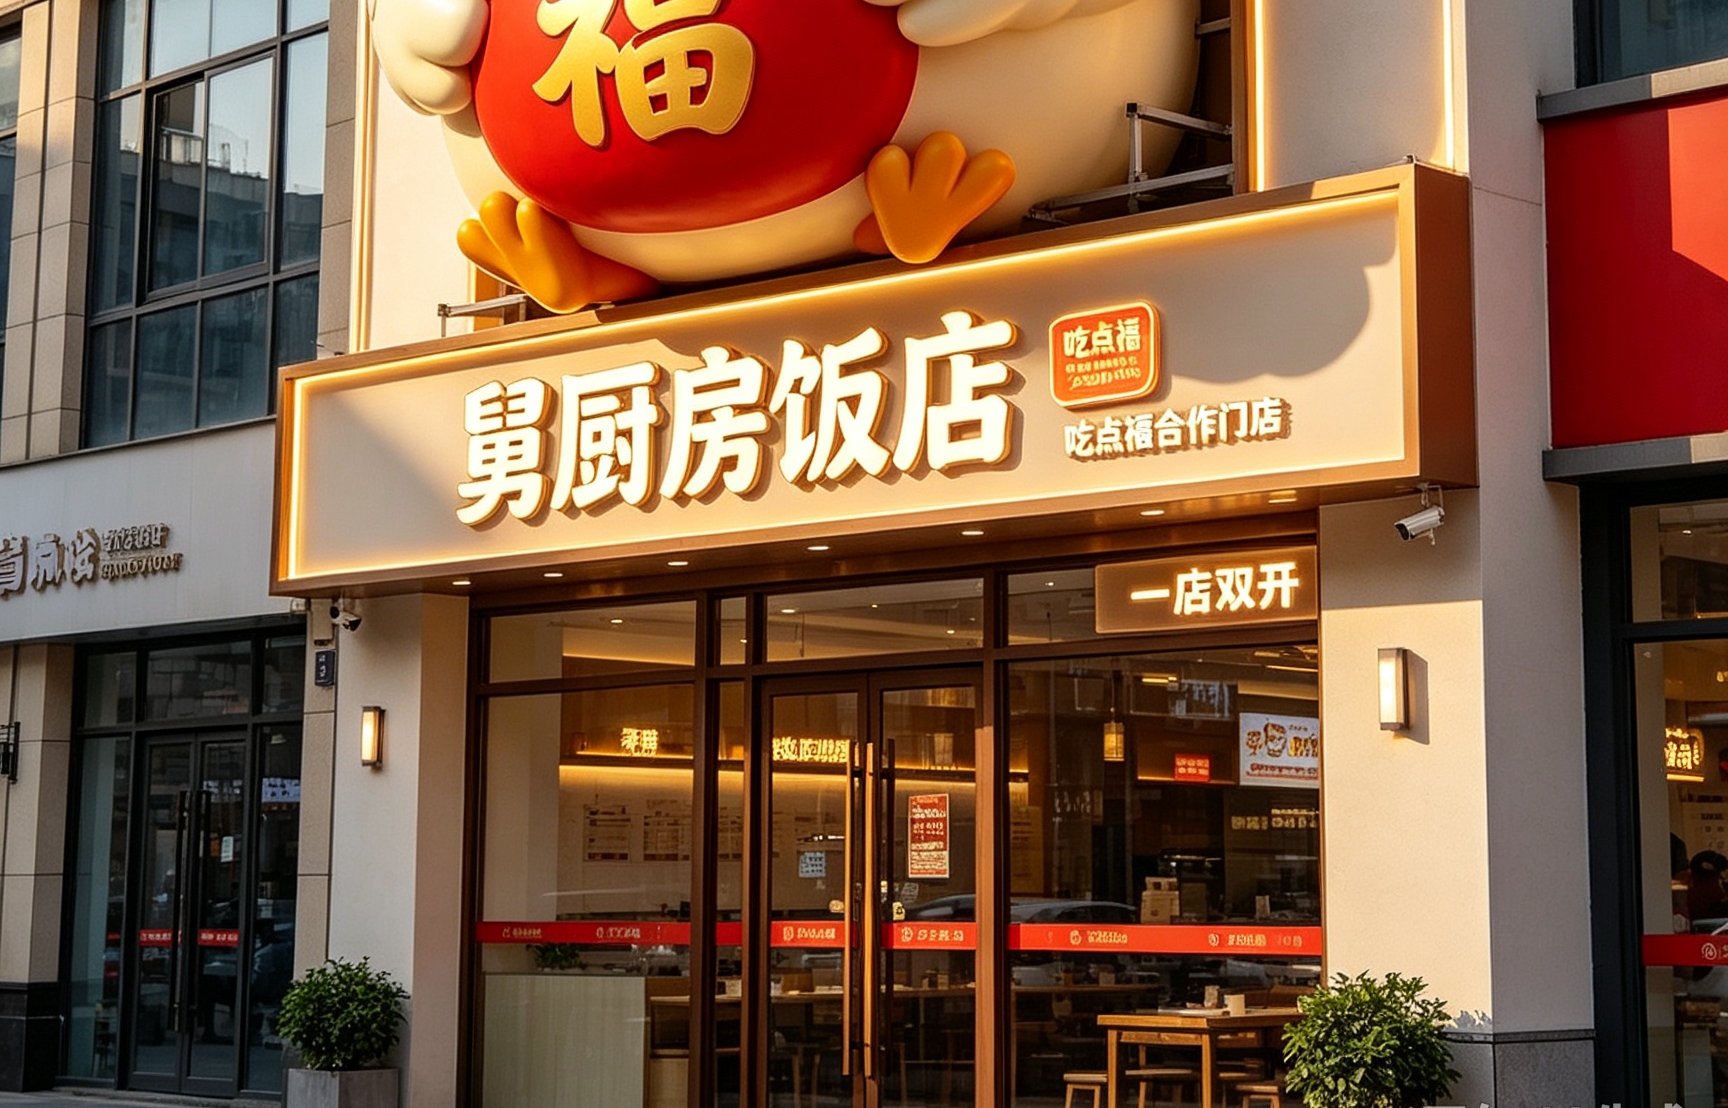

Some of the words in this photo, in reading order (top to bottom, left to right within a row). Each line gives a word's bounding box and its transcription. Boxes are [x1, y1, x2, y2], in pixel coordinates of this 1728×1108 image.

[1063, 316, 1141, 359] 吃点福
[456, 310, 1014, 525] 舅厨房饭店
[1064, 397, 1284, 457] 吃点福合作门店
[1130, 561, 1300, 616] 一店双开
